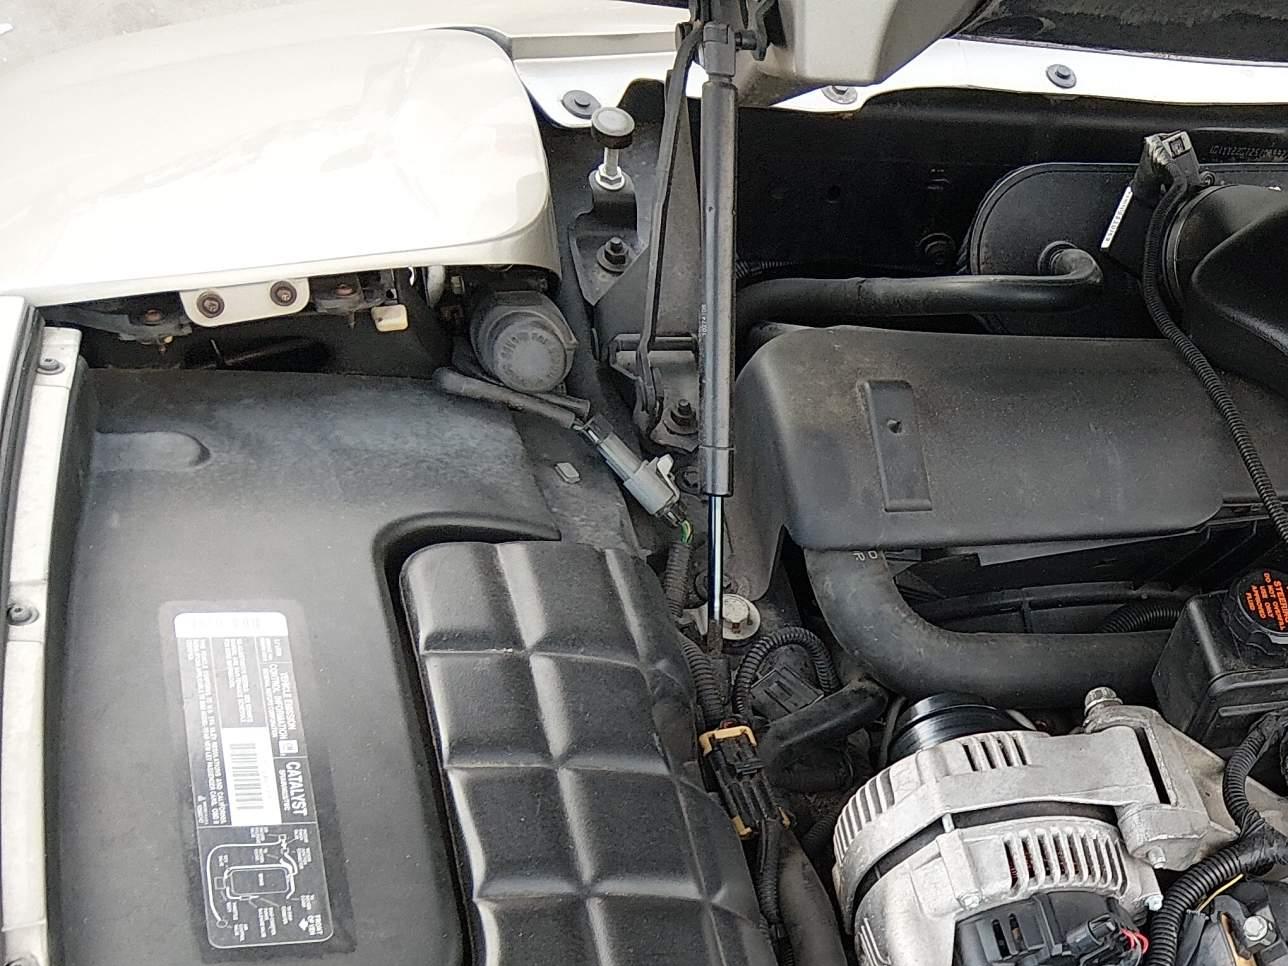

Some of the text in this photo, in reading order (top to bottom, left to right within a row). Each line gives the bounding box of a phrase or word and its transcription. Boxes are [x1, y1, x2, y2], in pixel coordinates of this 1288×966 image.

[1245, 592, 1255, 611] FLUID
[1251, 585, 1265, 619] APPROVED
[1263, 572, 1285, 631] DO NOT OVERFILL
[1264, 601, 1274, 618] ONLY
[268, 663, 281, 693] CONTROL
[285, 761, 308, 817] CATALYST
